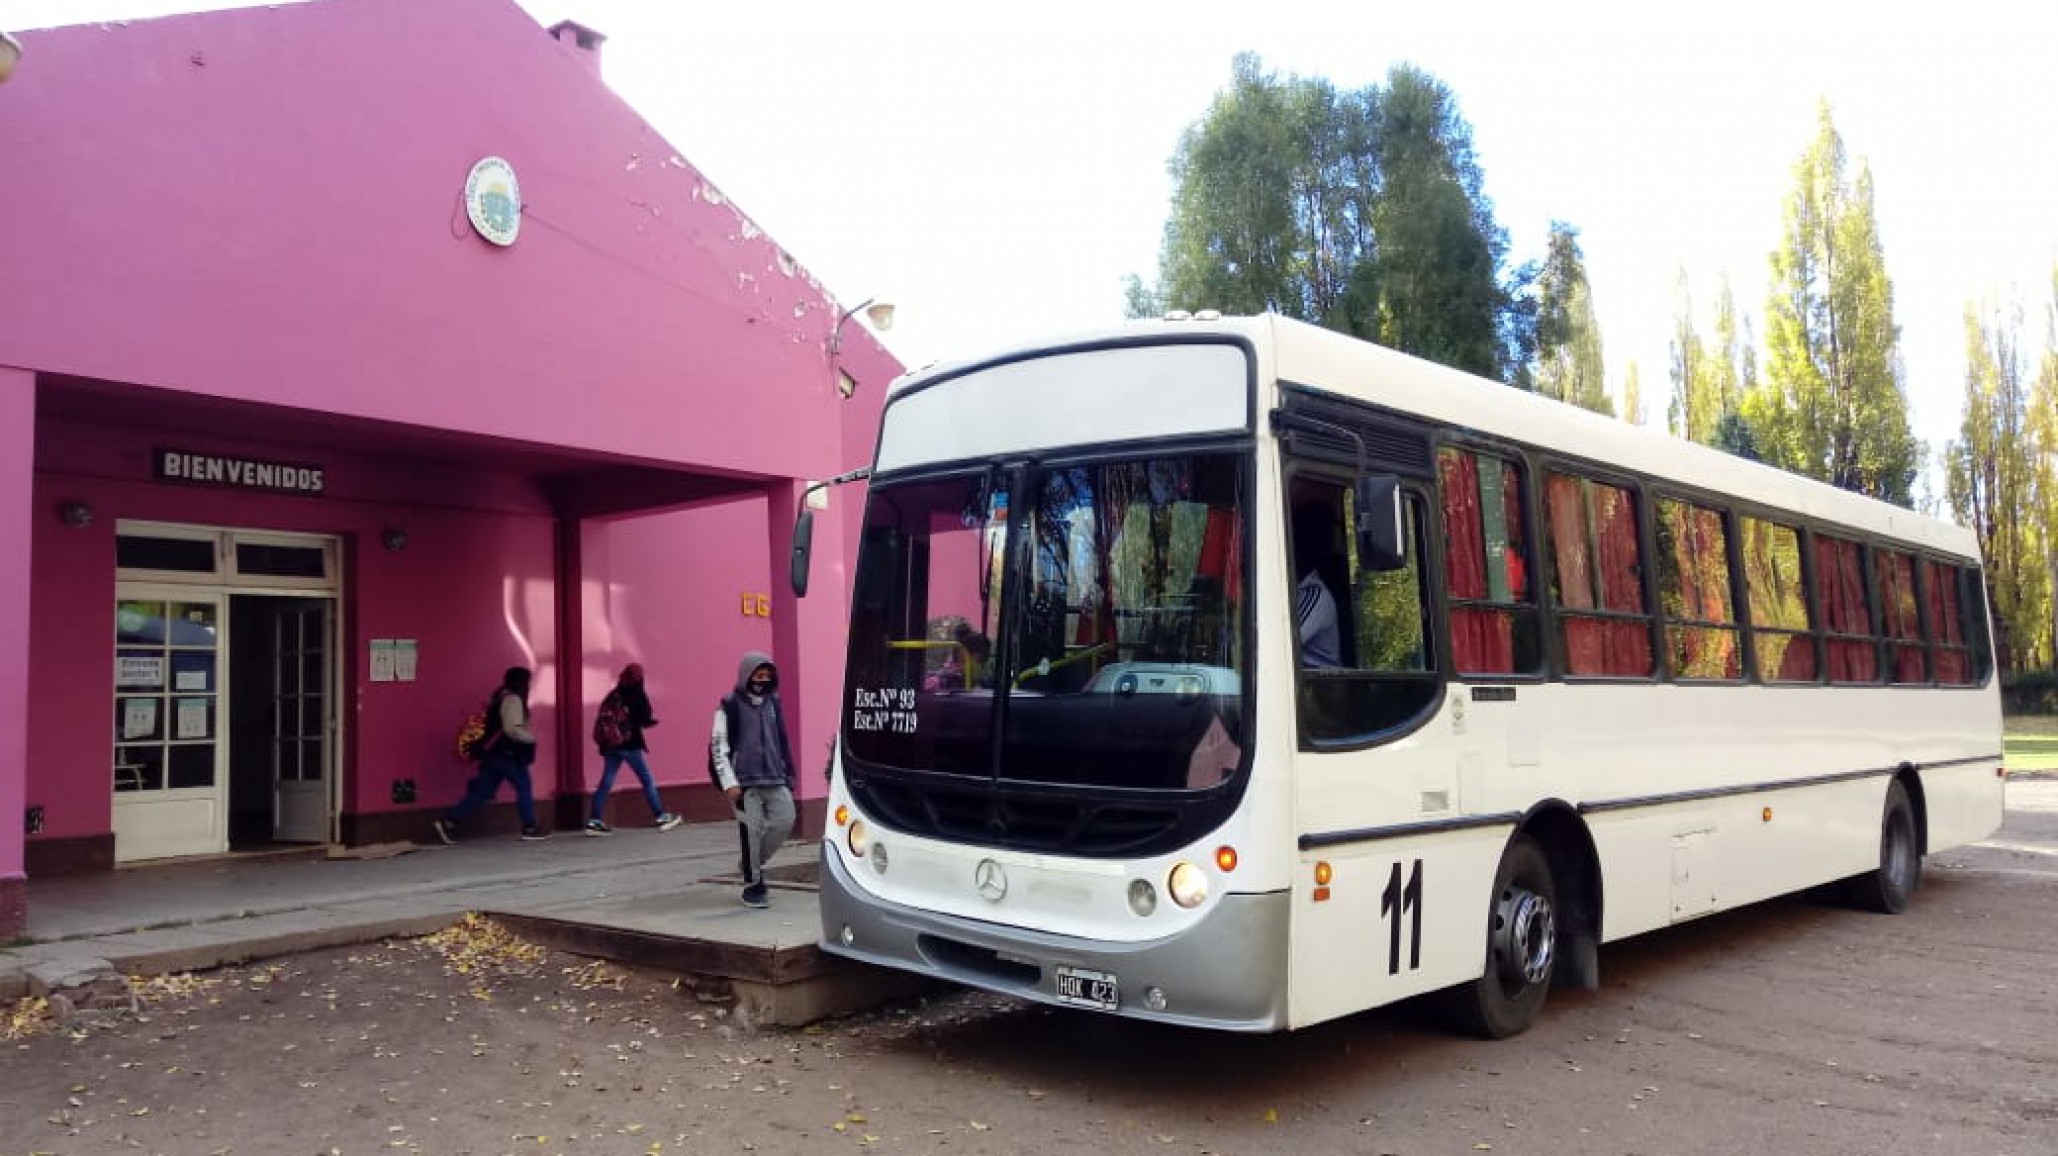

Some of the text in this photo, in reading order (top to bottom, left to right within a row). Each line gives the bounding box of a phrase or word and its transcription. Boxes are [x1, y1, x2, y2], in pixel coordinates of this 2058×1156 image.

[163, 452, 324, 491] BIENVENIDOS
[899, 688, 915, 710] 93
[891, 711, 918, 734] 7719
[1381, 859, 1423, 976] 11
[1091, 981, 1116, 1003] 423
